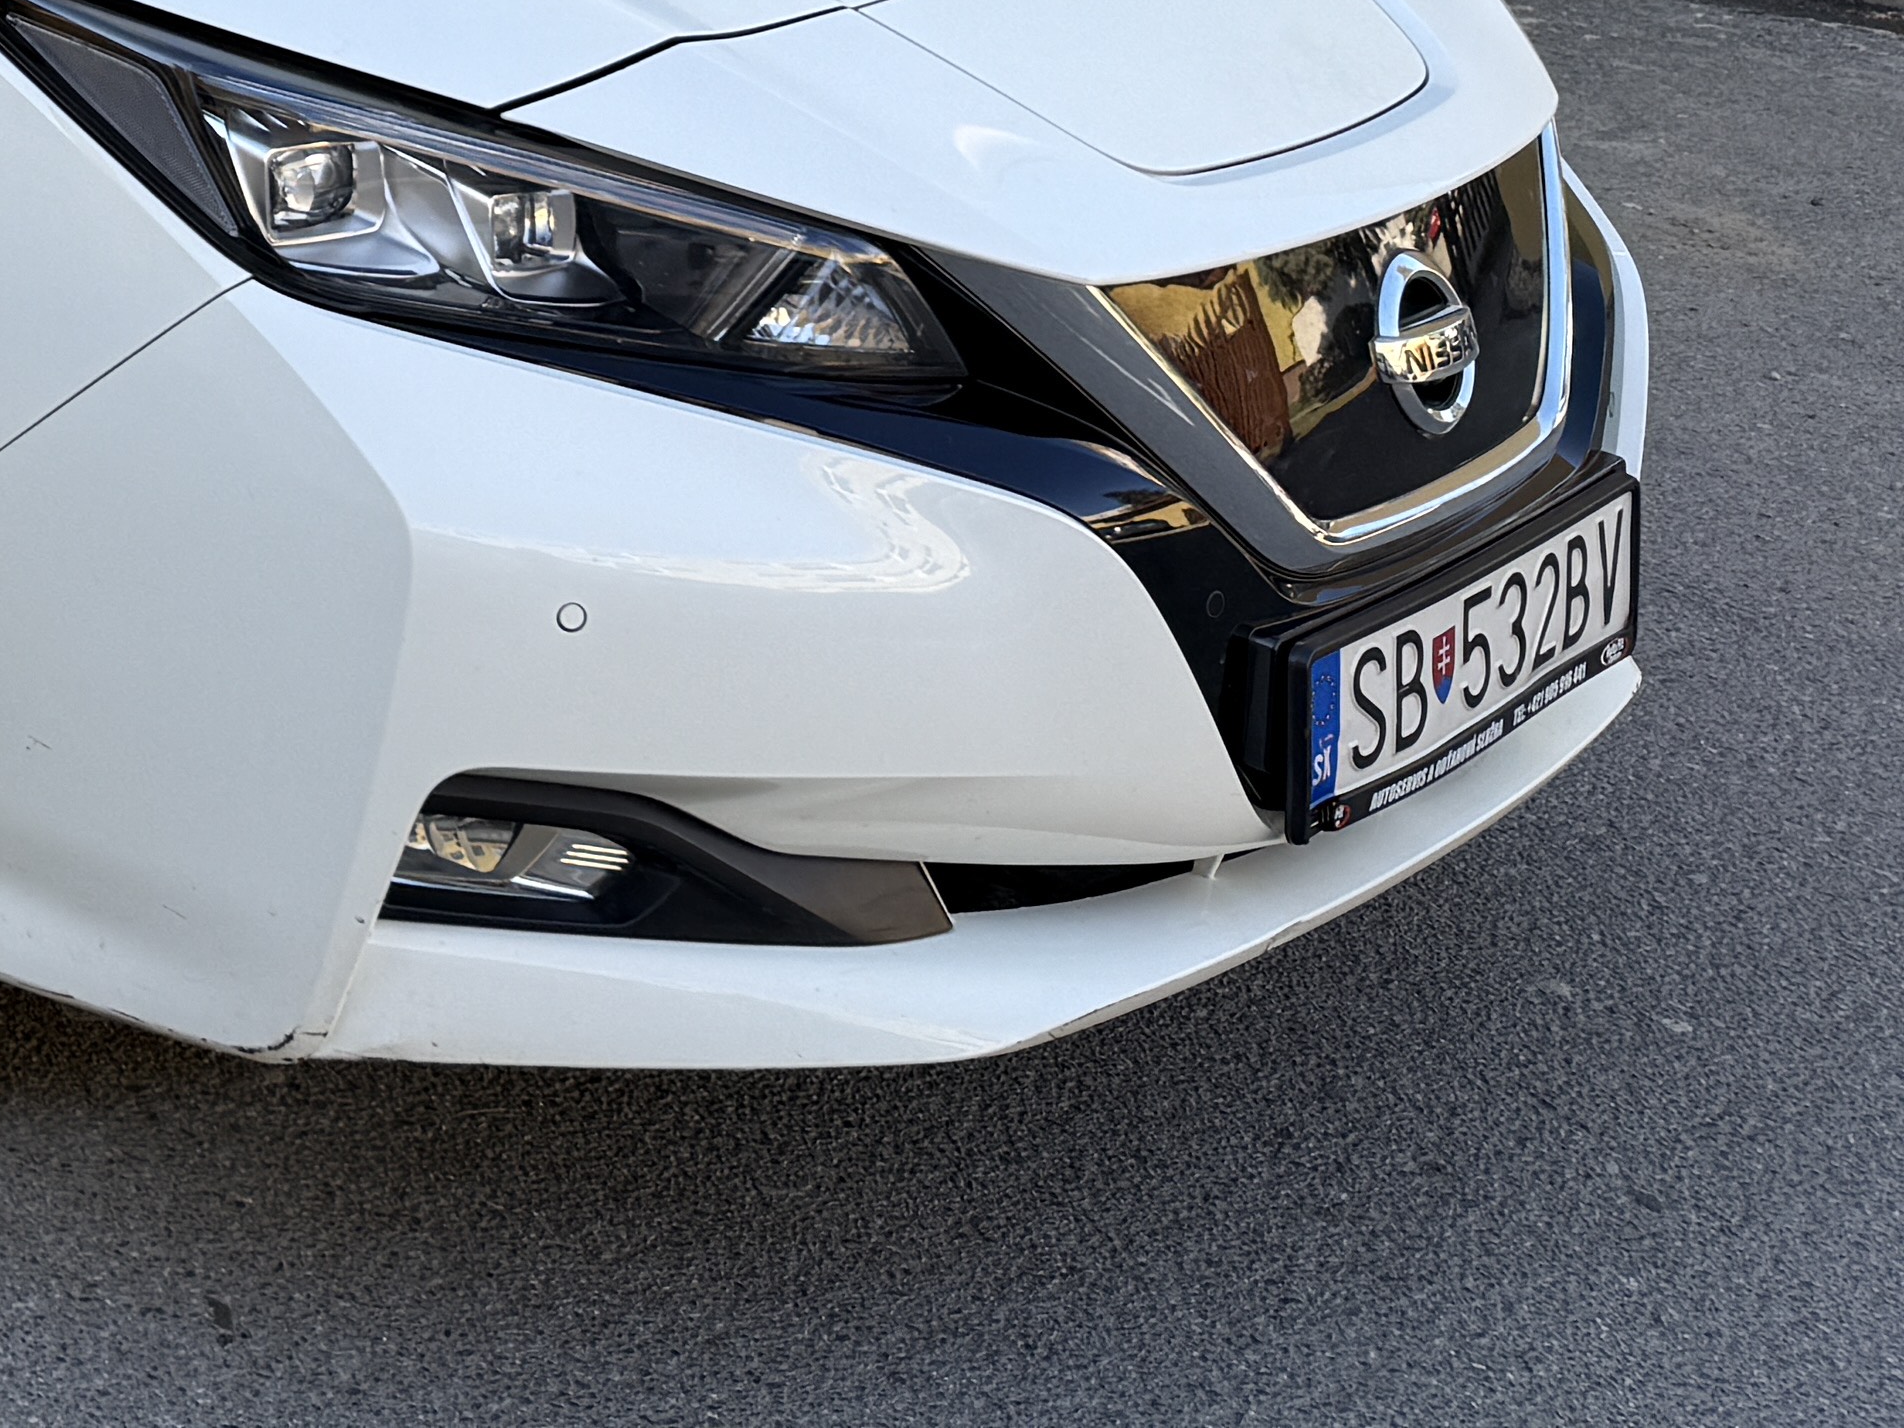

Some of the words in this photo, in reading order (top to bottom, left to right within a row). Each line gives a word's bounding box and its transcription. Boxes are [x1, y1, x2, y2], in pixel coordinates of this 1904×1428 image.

[1352, 629, 1428, 770] SB
[1461, 508, 1625, 710] 532BV
[1312, 744, 1332, 786] SK
